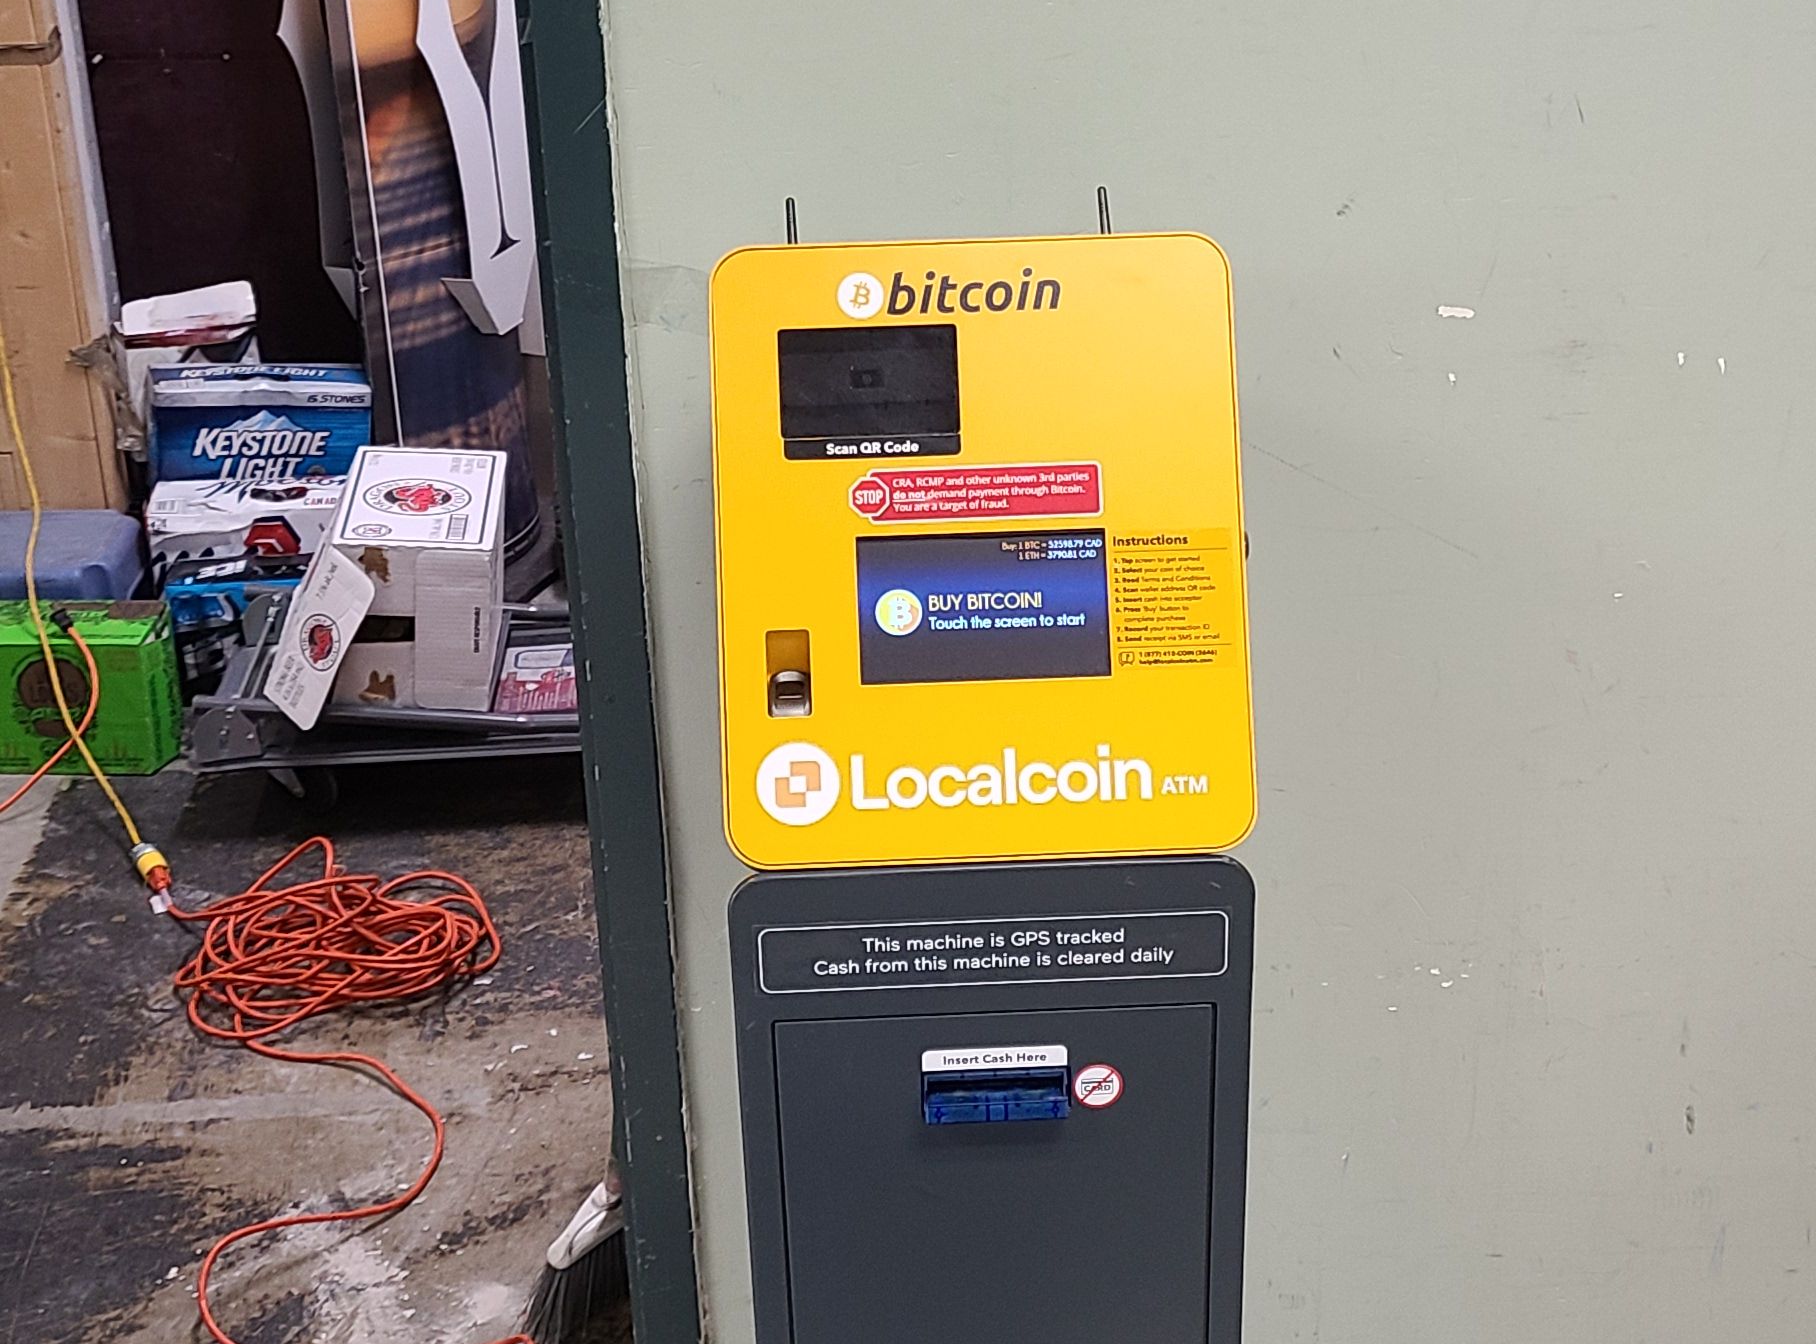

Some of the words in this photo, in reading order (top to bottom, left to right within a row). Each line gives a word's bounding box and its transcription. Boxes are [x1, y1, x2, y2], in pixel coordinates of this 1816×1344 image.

[887, 267, 1061, 316] bitcoin
[273, 366, 328, 377] LIGHT
[321, 394, 366, 403] STONES
[193, 428, 331, 460] KEYSTONE
[826, 443, 858, 456] Scan
[860, 442, 882, 455] QR
[883, 441, 920, 454] Code
[219, 457, 303, 481] LIGHT
[892, 477, 914, 489] CRA,
[916, 476, 944, 487] RCMP
[945, 475, 964, 486] and
[966, 474, 991, 486] other
[993, 473, 1037, 485] unknown
[1039, 472, 1055, 483] 3rd
[1057, 471, 1090, 484] parties
[854, 489, 884, 505] STOP
[892, 491, 907, 500] do
[908, 490, 925, 500] not
[927, 489, 966, 499] demand
[968, 488, 1009, 500] payment
[1011, 486, 1049, 499] through
[1051, 484, 1086, 495] Bitcoin.
[303, 497, 337, 506] CANAD
[893, 502, 911, 513] You
[914, 502, 929, 512] are
[931, 502, 938, 511] a
[939, 501, 967, 513] target
[969, 499, 980, 510] of
[981, 499, 1010, 510] fraud.
[1018, 541, 1024, 550] 1
[1024, 540, 1040, 550] BTC
[1085, 538, 1103, 548] CAD
[1112, 534, 1189, 547] Instructions
[1018, 551, 1024, 561] 1
[1024, 551, 1040, 560] ETH
[1079, 549, 1097, 558] CAD
[928, 593, 963, 612] BUY
[967, 591, 1043, 610] BITCOIN!
[928, 614, 968, 631] Touch
[970, 614, 992, 630] the
[994, 616, 1037, 628] screen
[1039, 614, 1054, 627] to
[1056, 612, 1086, 626] start
[851, 743, 1153, 810] Localcoin
[1161, 775, 1209, 796] ATM
[862, 936, 901, 954] This
[906, 933, 984, 952] machine
[989, 932, 1006, 949] is
[1010, 930, 1052, 948] GPS
[1055, 927, 1125, 946] tracked
[813, 958, 860, 976] Cash
[865, 957, 908, 974] from
[913, 954, 947, 971] this
[951, 951, 1032, 969] machine
[1036, 950, 1053, 967] is
[1057, 947, 1125, 965] cleared
[1130, 946, 1175, 965] daily
[943, 1054, 980, 1066] Insert
[982, 1052, 1013, 1064] Cash
[1016, 1052, 1047, 1063] Here
